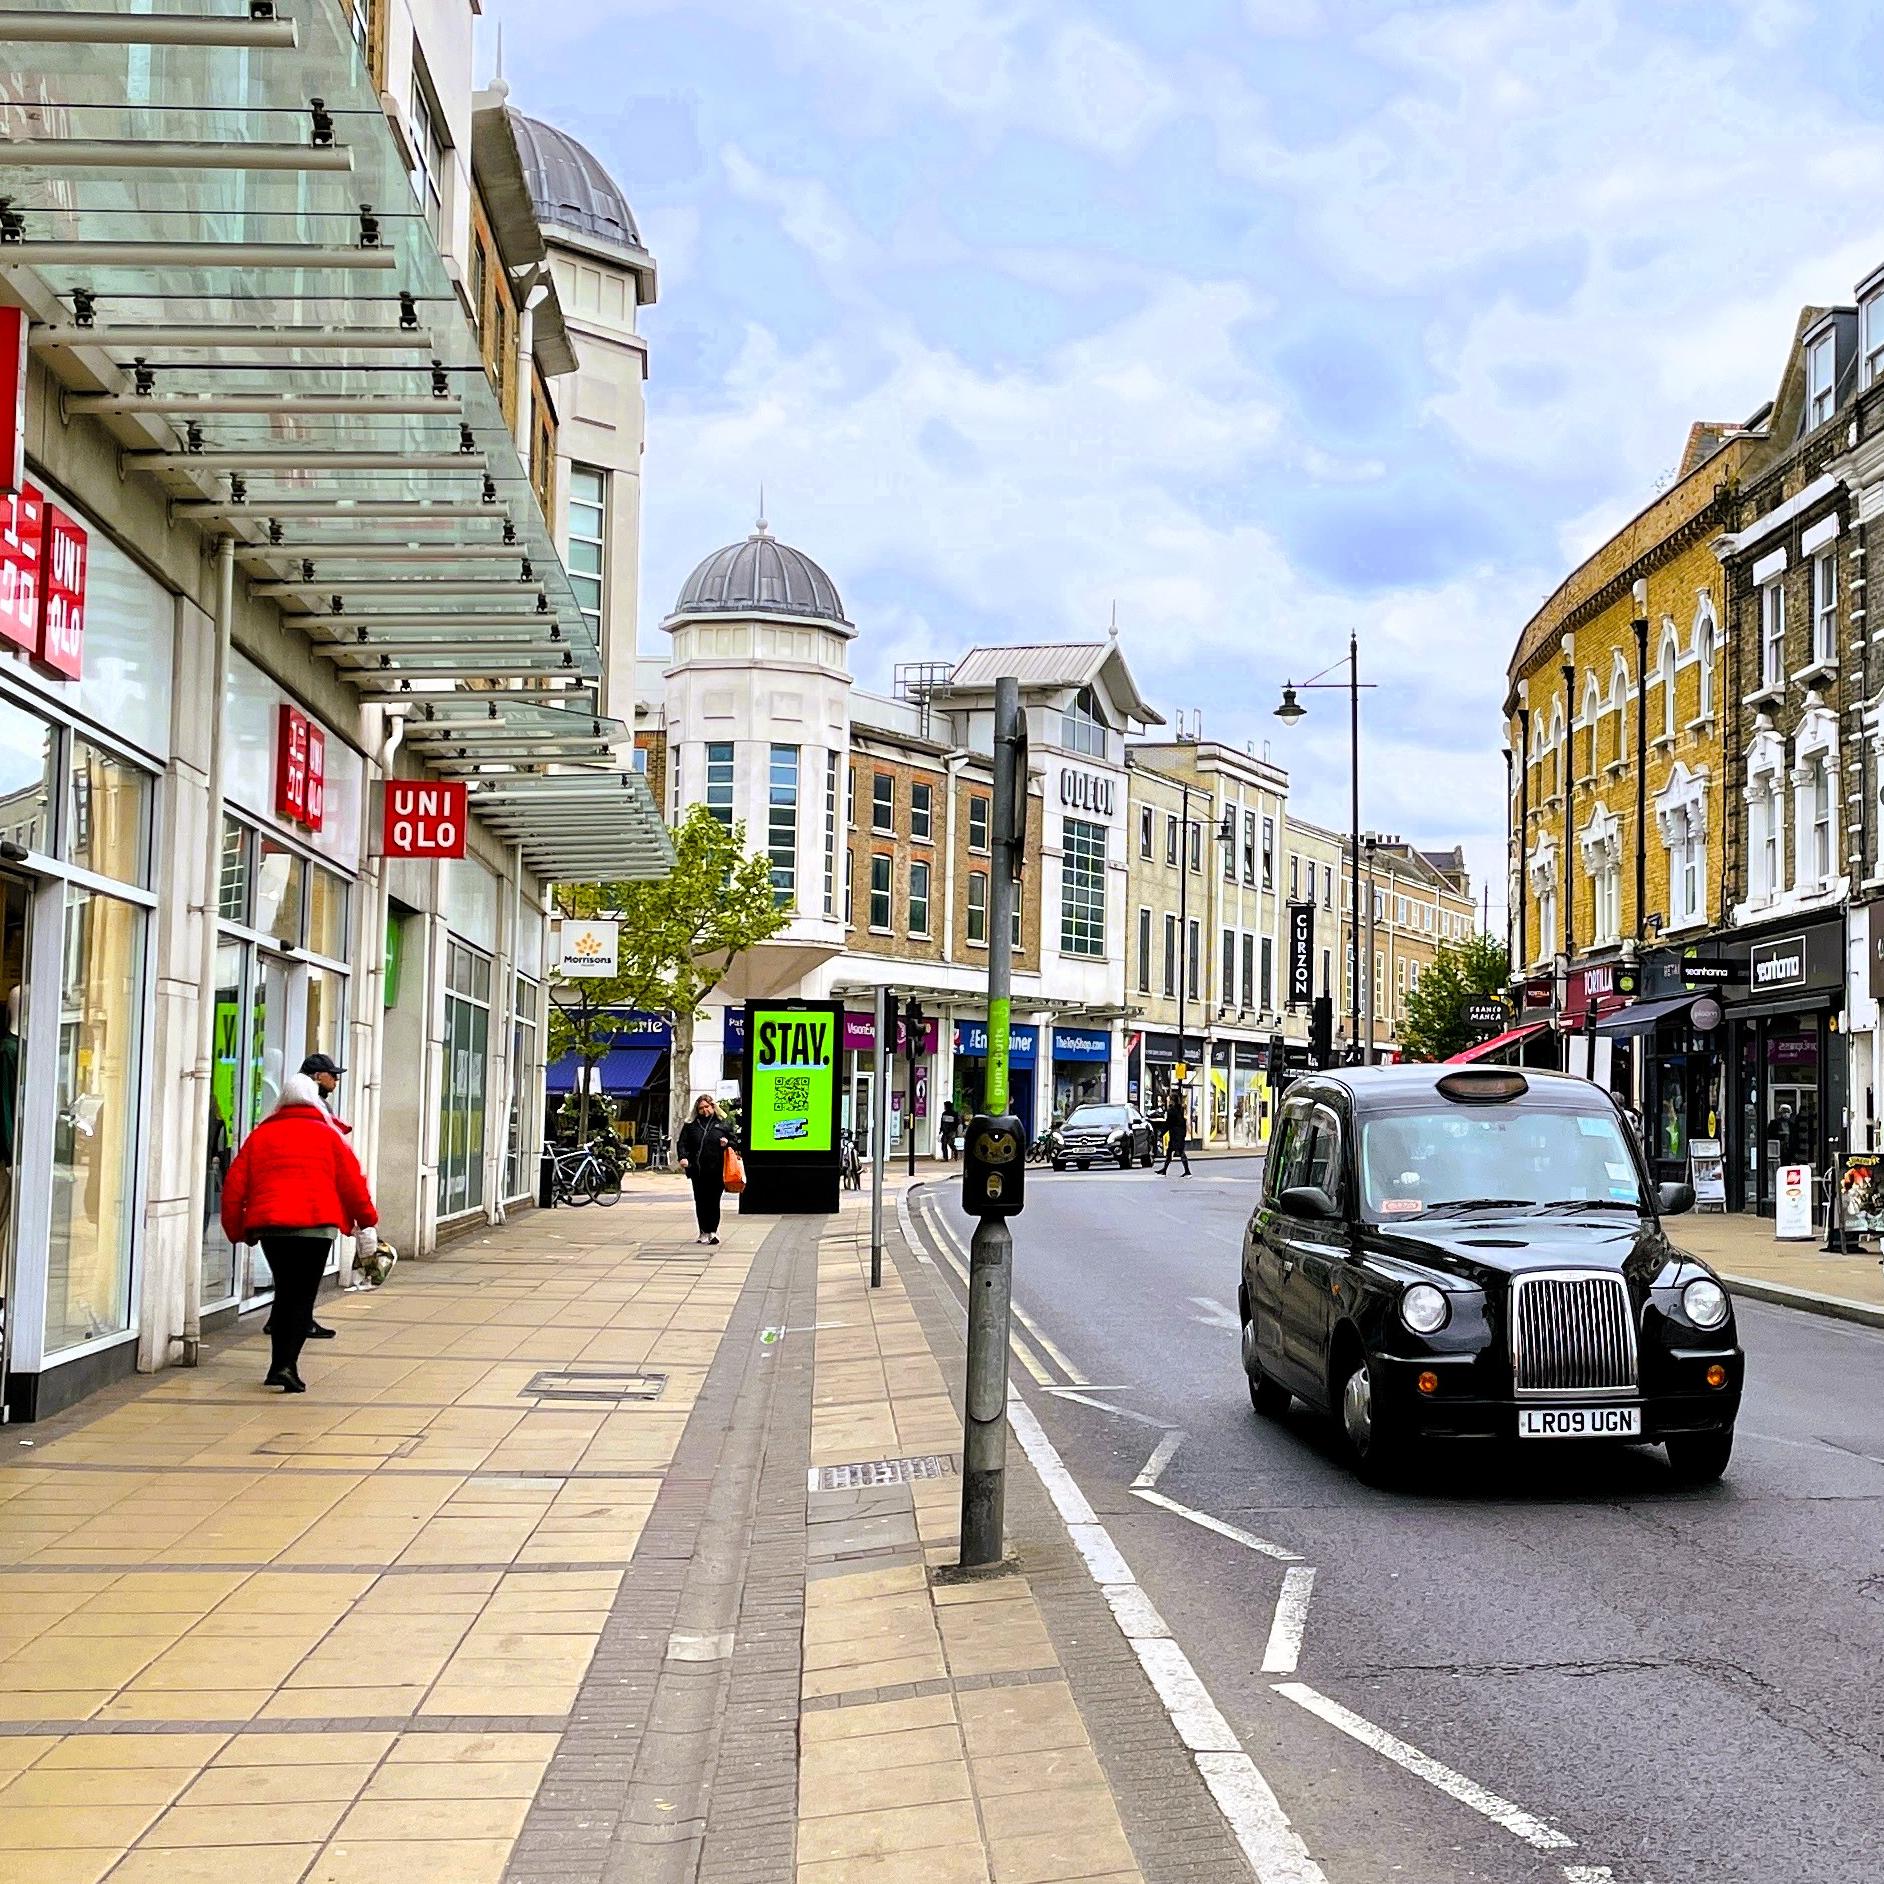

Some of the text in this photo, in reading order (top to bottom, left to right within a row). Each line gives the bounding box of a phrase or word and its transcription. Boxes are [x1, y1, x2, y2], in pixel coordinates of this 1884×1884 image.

[53, 527, 81, 596] UNI
[50, 593, 80, 657] QLO
[310, 736, 323, 777] UNI
[308, 779, 322, 820] QLO
[395, 790, 451, 817] UNI
[1061, 768, 1115, 816] ODEON
[393, 821, 456, 852] QLO
[564, 953, 611, 963] Morrisons
[1295, 914, 1308, 994] CURZON
[1584, 966, 1614, 996] TORTILLA
[760, 1021, 830, 1066] STAY.
[974, 1029, 1033, 1052] Eniner
[1056, 1036, 1106, 1053] TheToyShop.com
[1528, 1410, 1632, 1433] LR09 UGN
